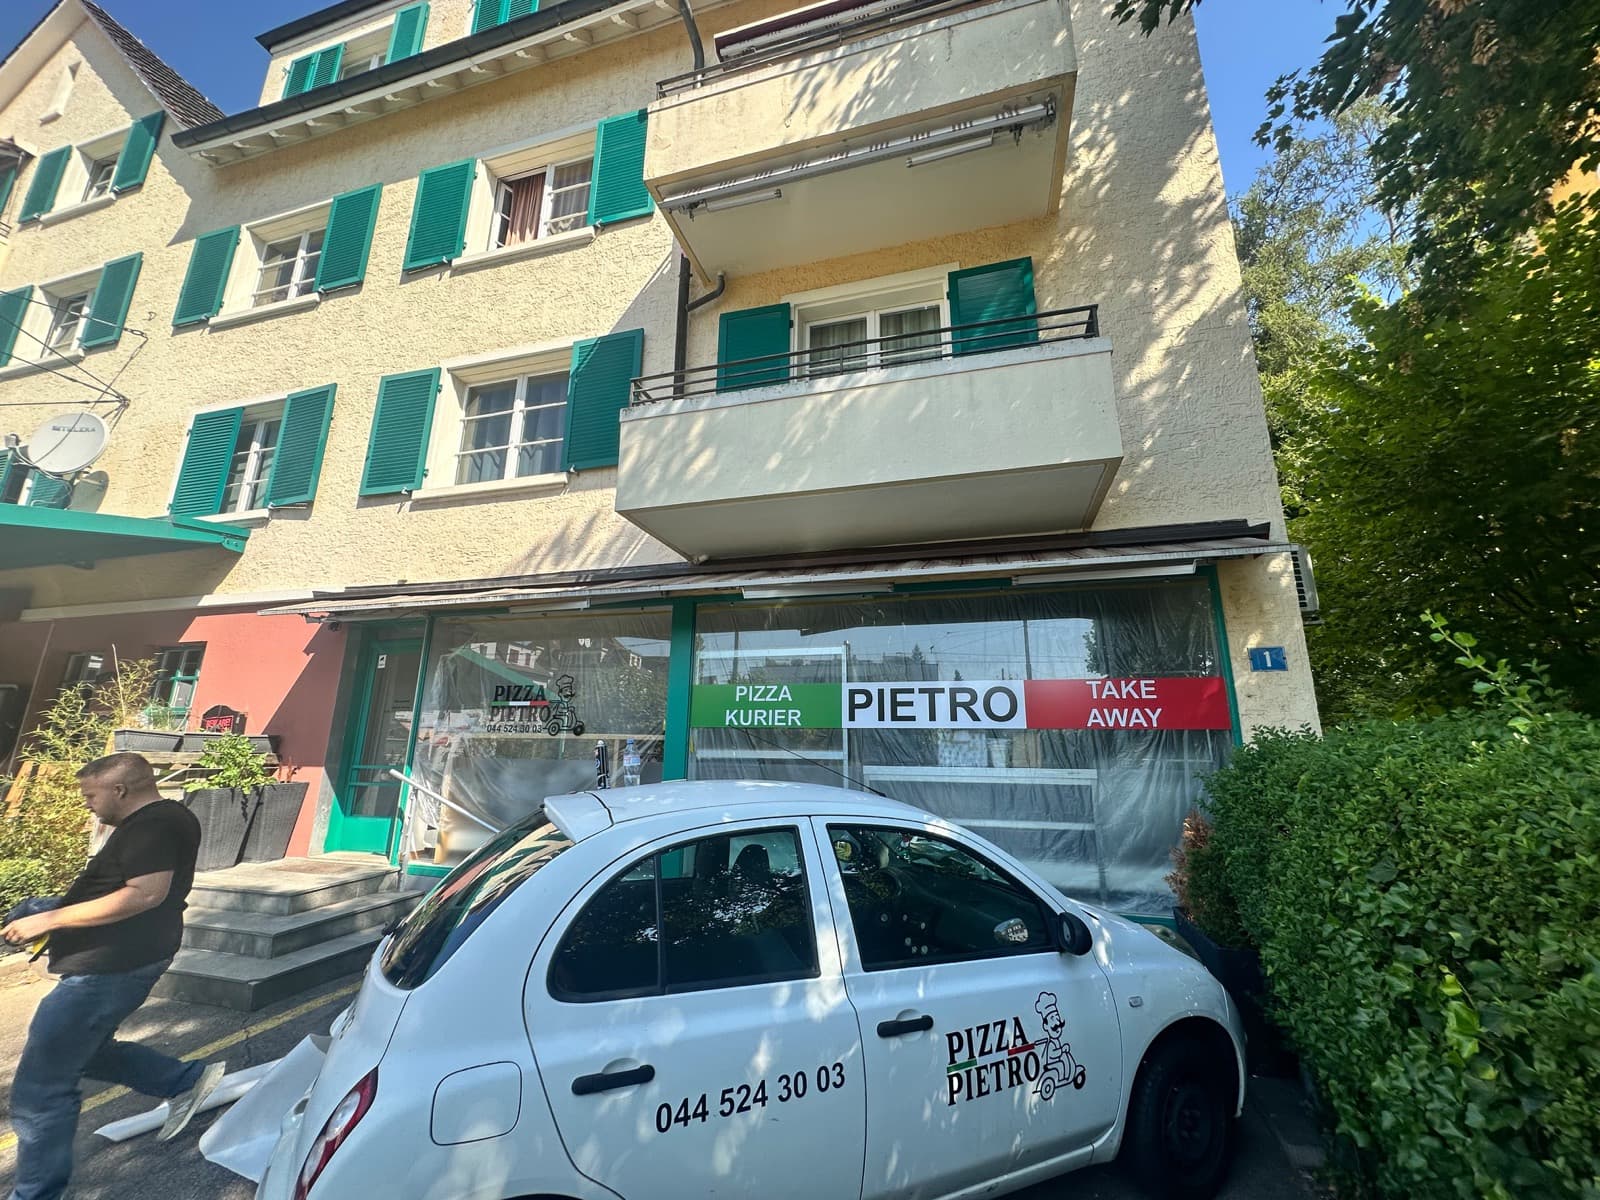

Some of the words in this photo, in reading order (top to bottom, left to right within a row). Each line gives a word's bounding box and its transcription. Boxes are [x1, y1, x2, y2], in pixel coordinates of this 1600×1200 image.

[1264, 651, 1272, 667] 1
[493, 684, 547, 701] PIZZA
[735, 685, 793, 702] PIZZA
[1085, 679, 1158, 700] TAKE
[848, 685, 1019, 723] PIETRO
[490, 705, 551, 722] PIETRO
[725, 709, 801, 726] KURIER
[1086, 708, 1162, 728] AWAY
[486, 724, 501, 733] 044
[503, 724, 518, 733] 524
[520, 724, 530, 733] 30
[532, 724, 542, 733] 03
[945, 1016, 1030, 1066] PIZZA
[947, 1051, 1041, 1107] PIETRO
[655, 1093, 709, 1133] 044
[719, 1079, 769, 1117] 524
[777, 1070, 808, 1102] 30
[816, 1062, 846, 1093] 03
